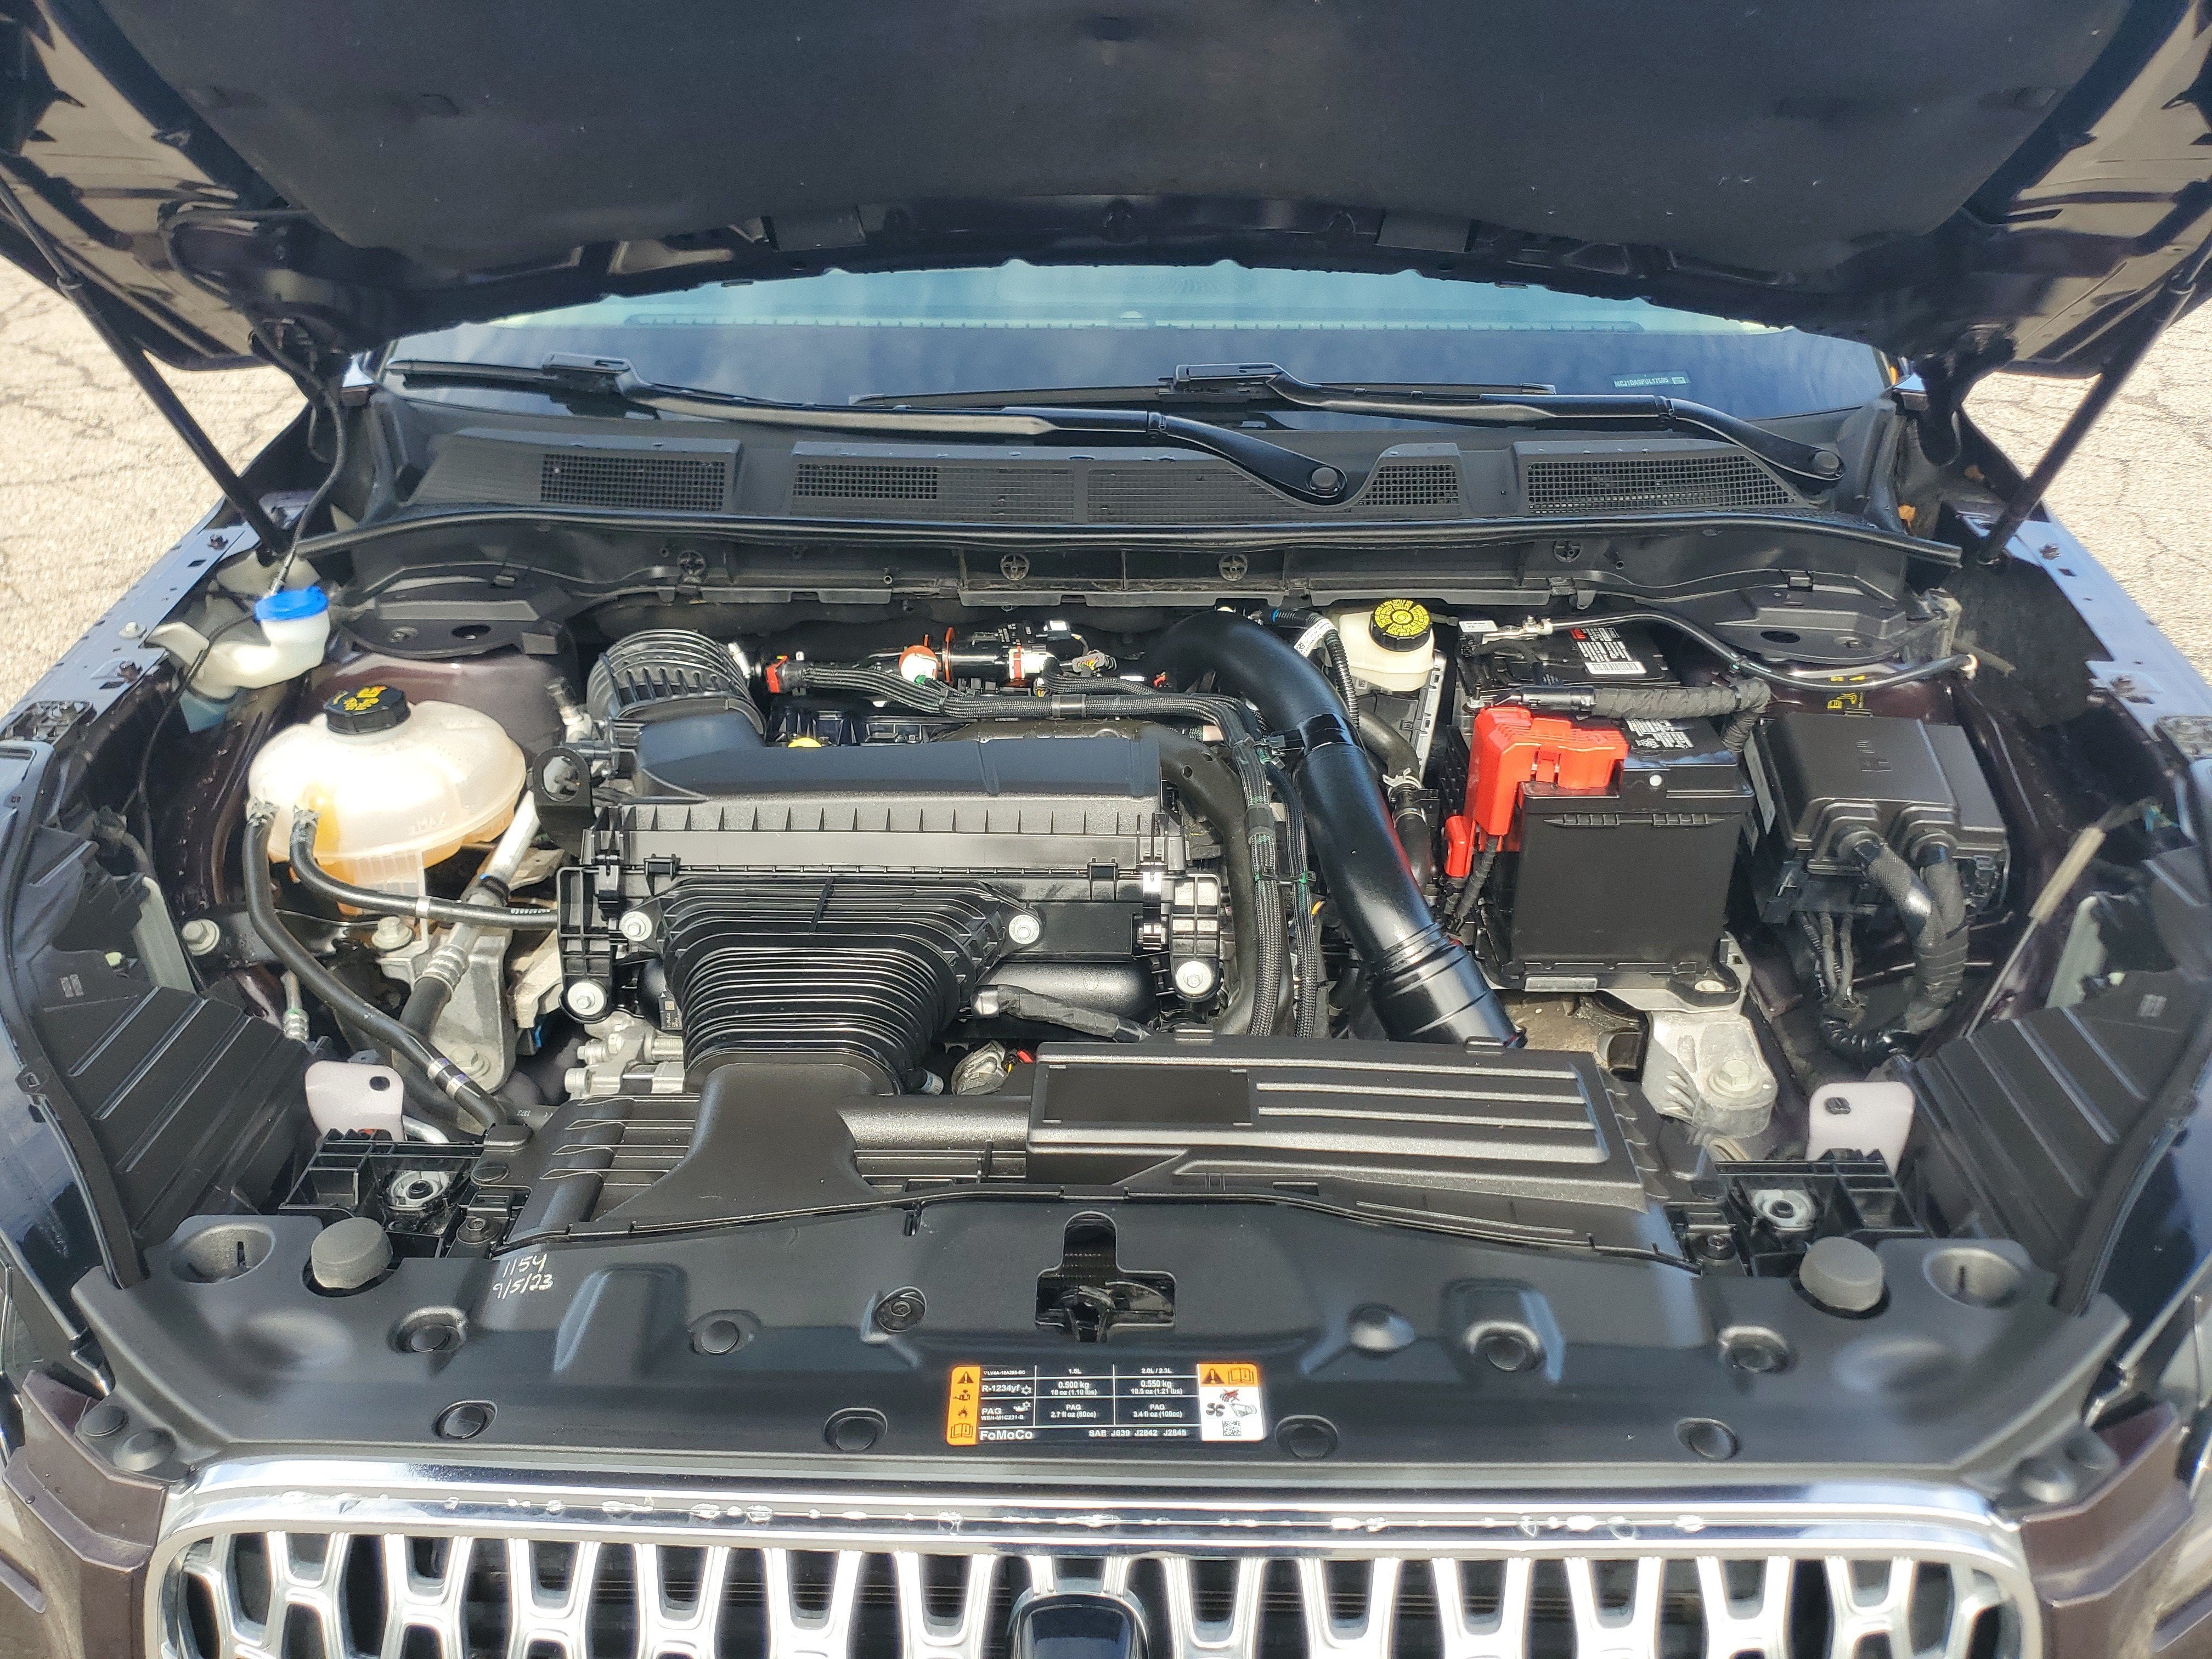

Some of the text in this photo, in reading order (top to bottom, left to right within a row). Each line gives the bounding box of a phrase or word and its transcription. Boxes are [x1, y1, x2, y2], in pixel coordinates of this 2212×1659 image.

[503, 1253, 547, 1278] 1154
[493, 1273, 554, 1300] 9/5/23
[981, 1384, 1020, 1393] R-1234yf
[1080, 1381, 1090, 1389] kg
[1162, 1380, 1172, 1388] kg
[980, 1429, 1033, 1441] FoMoCo
